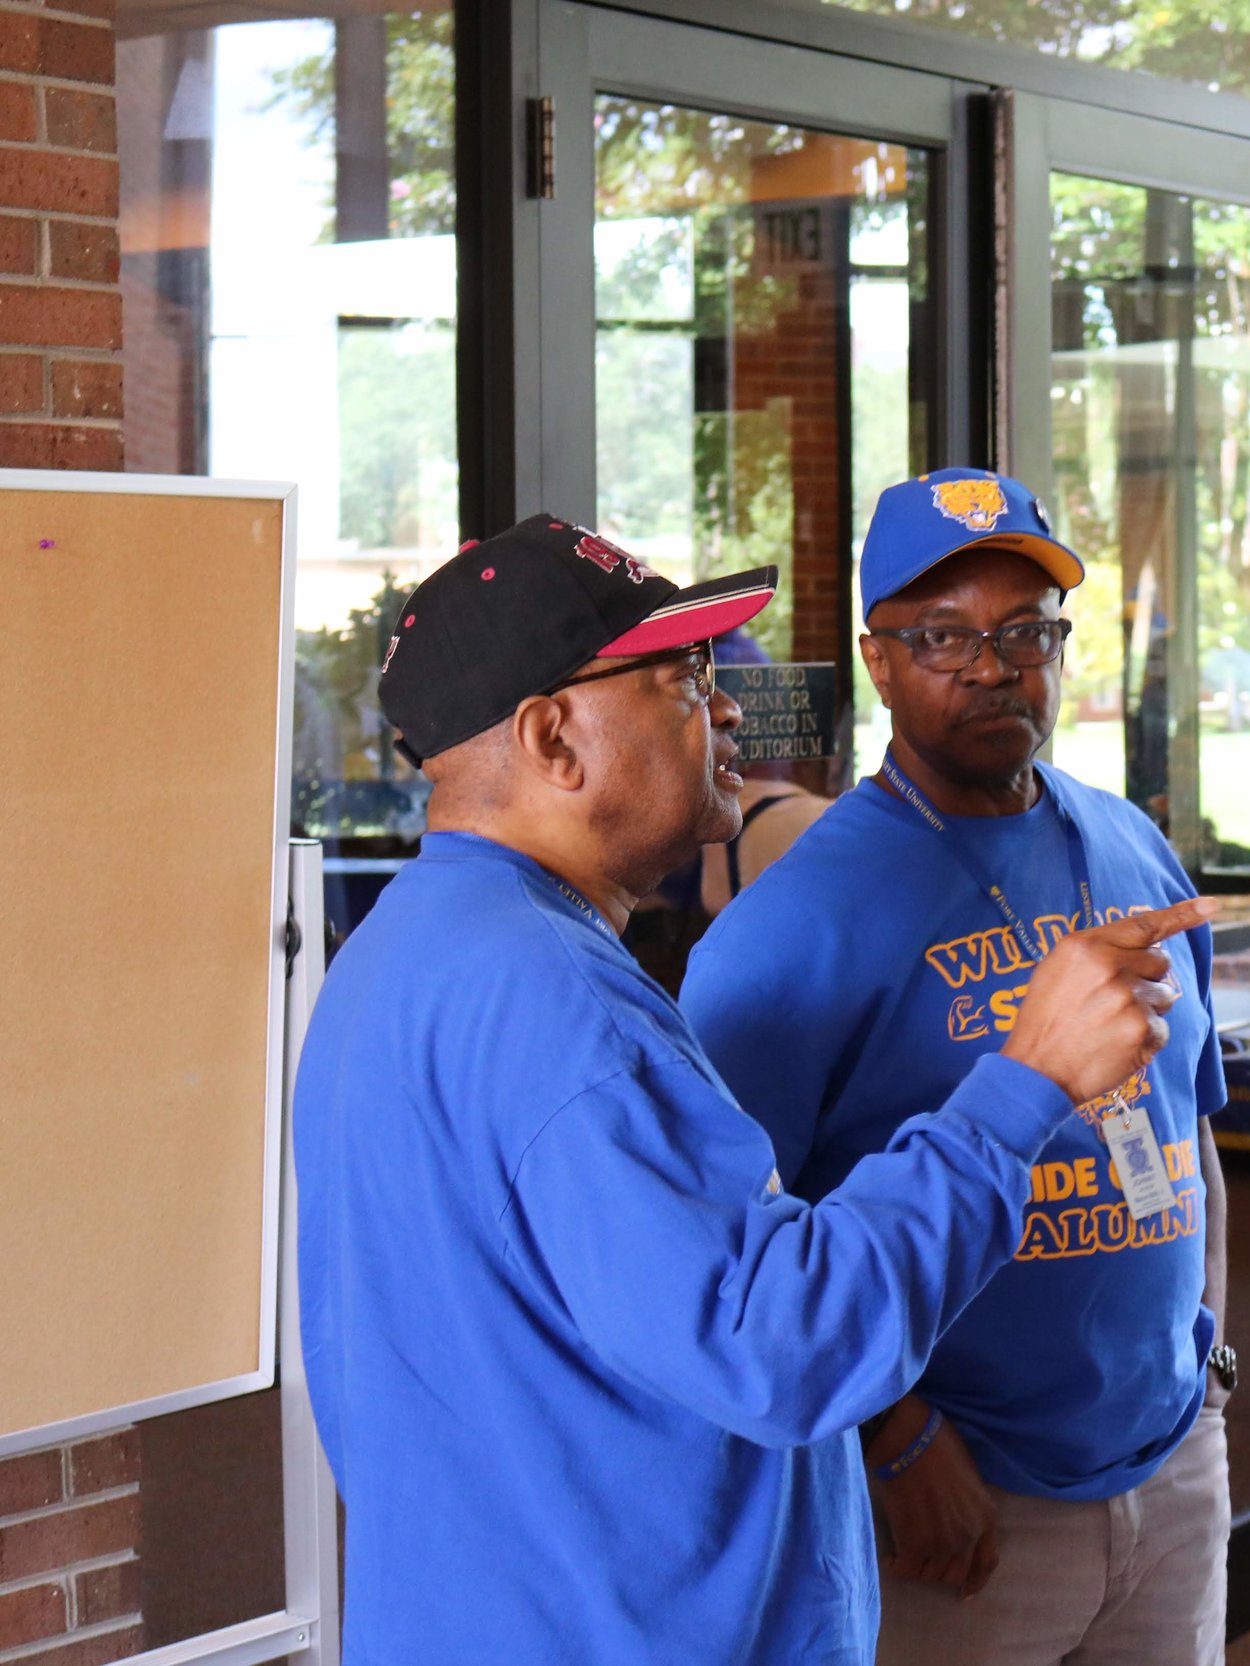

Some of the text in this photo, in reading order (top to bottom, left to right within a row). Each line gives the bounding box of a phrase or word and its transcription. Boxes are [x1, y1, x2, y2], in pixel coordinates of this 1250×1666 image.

[742, 667, 806, 688] NO FOOD
[739, 690, 811, 711] DRINK OR
[736, 712, 818, 736] OBACCO IN
[738, 736, 822, 760] UDITORIUM
[1030, 1156, 1100, 1203] IDE
